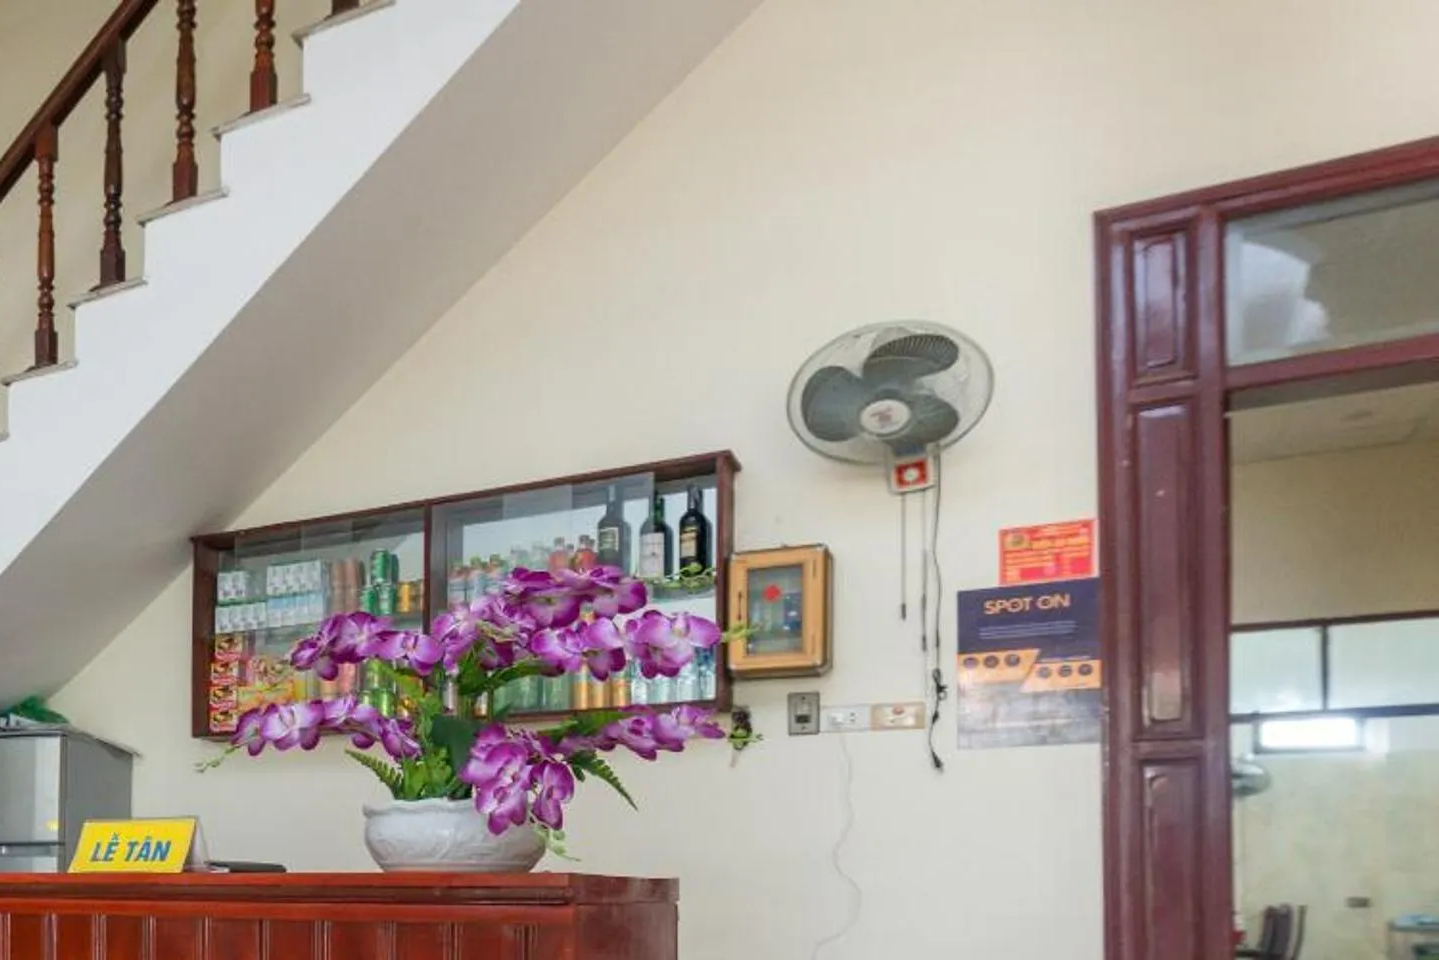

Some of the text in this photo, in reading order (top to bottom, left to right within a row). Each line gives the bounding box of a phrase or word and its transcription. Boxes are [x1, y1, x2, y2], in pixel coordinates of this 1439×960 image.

[983, 592, 1071, 616] SPOT ON
[124, 834, 172, 863] TÂN
